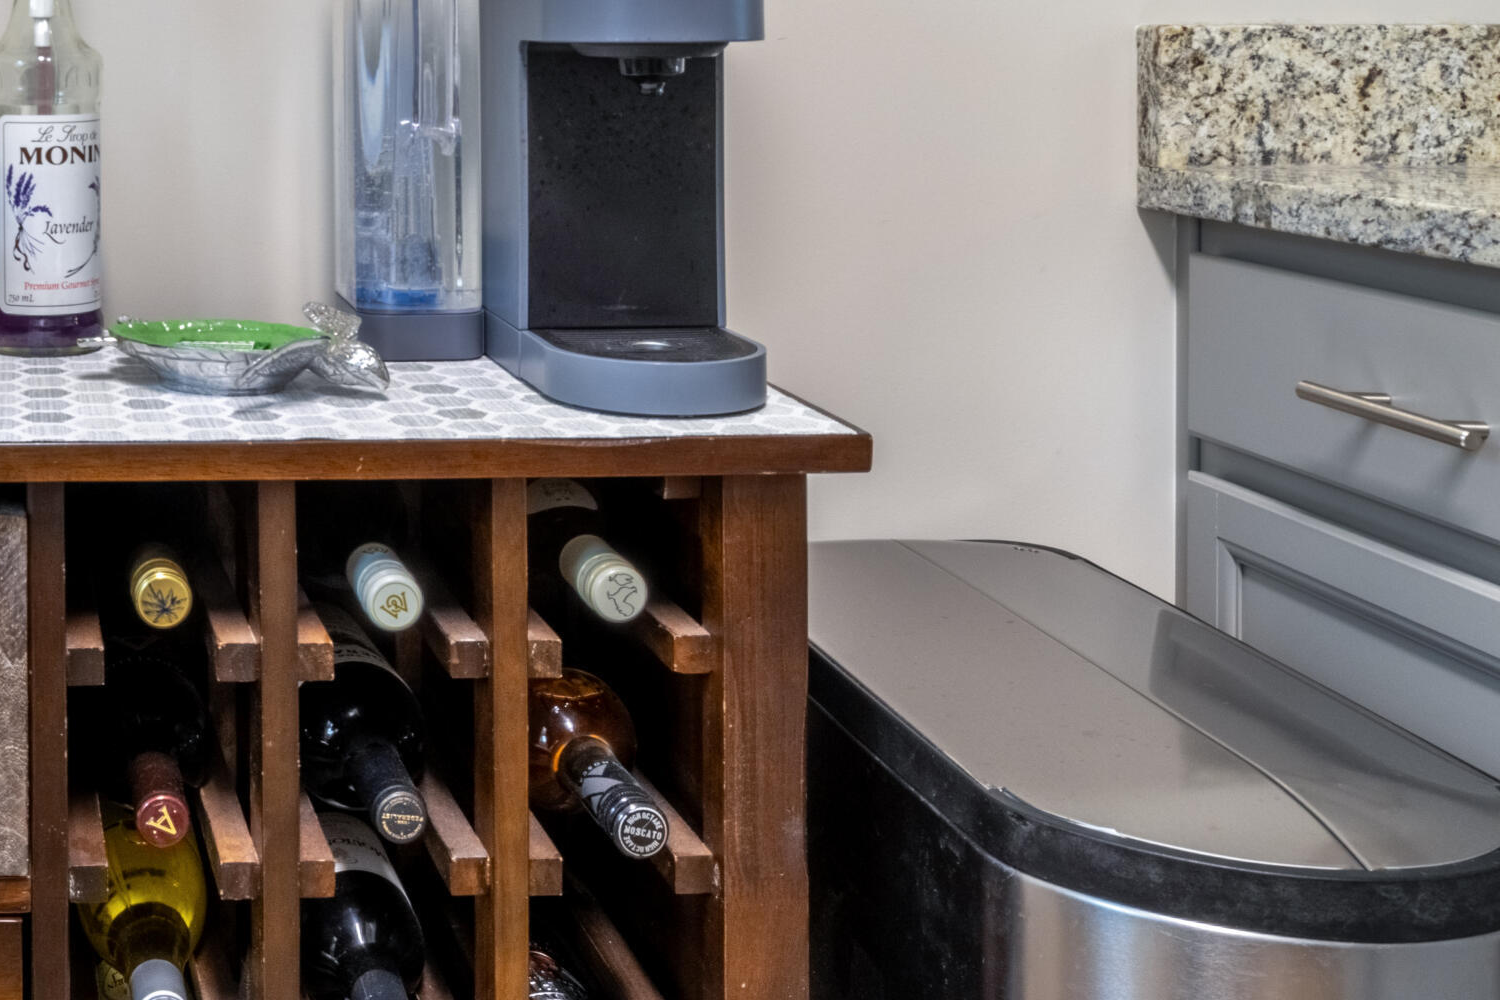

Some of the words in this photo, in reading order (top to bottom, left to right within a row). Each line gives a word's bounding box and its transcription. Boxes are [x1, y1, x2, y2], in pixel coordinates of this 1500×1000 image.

[31, 125, 54, 143] Le
[56, 124, 89, 146] Sirop
[42, 215, 94, 244] Lavender
[24, 282, 60, 291] Premium
[626, 812, 642, 826] HIGH
[642, 811, 664, 831] OCTANE
[623, 825, 663, 841] MOSCATO
